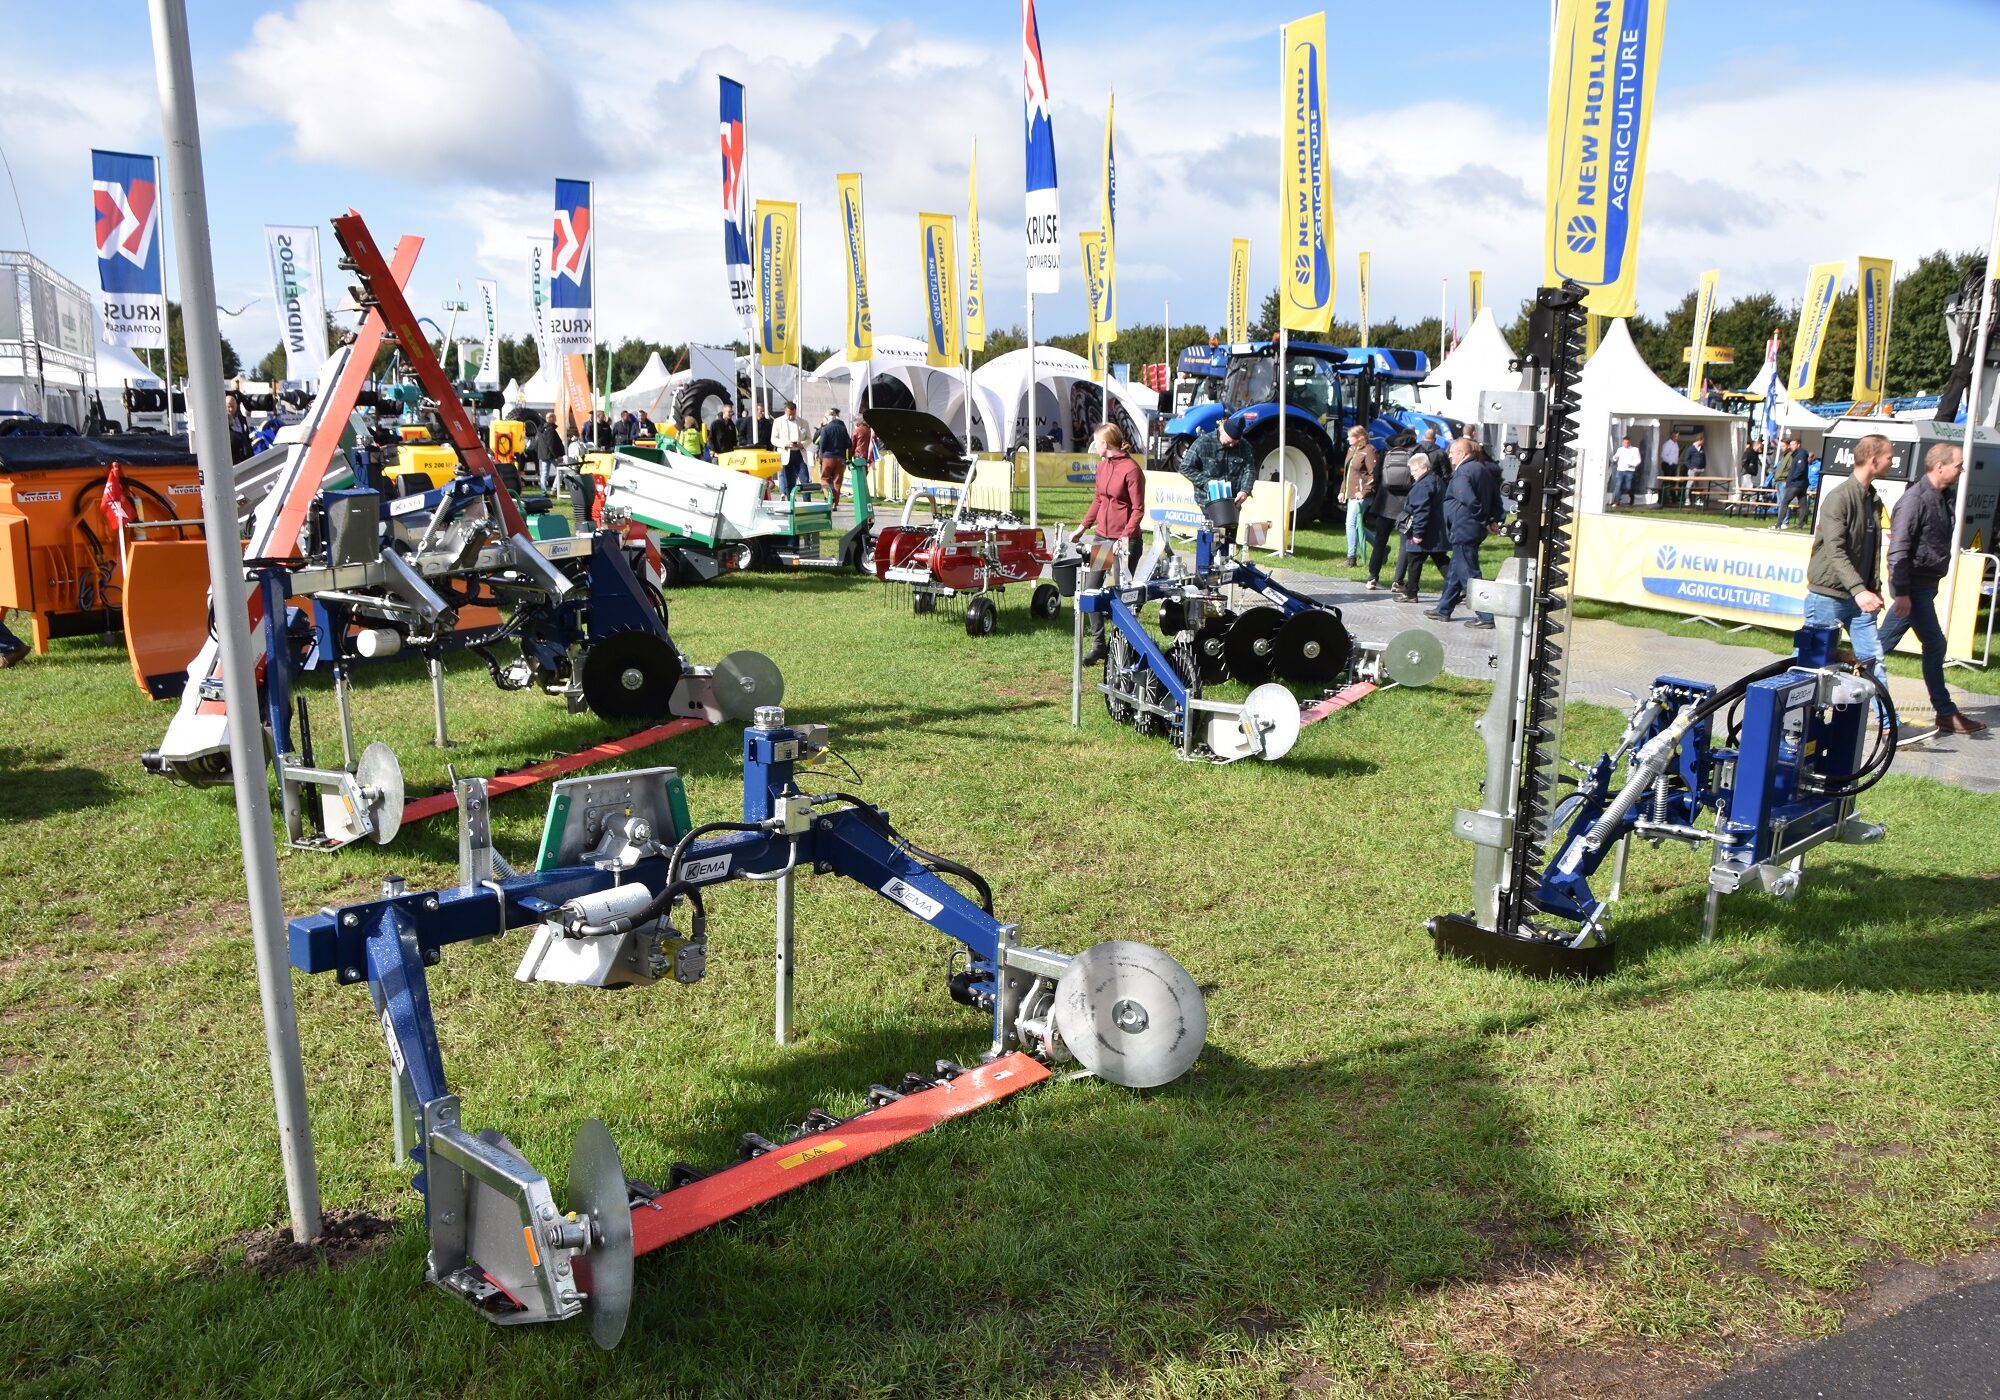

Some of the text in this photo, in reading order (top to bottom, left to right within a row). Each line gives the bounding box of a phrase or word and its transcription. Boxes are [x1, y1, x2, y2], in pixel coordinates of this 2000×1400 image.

[1577, 0, 1611, 206] NEW HOLLAN
[1612, 29, 1638, 209] AGRICULTURE
[1310, 109, 1323, 250] AGRICULTURE
[1299, 191, 1309, 247] NEW
[1966, 494, 1996, 509] OWER
[1681, 554, 1804, 584] NEW HOLLAND
[1677, 582, 1771, 608] AGRICULTURE
[685, 861, 725, 880] KEMA
[889, 881, 933, 914] KEMA
